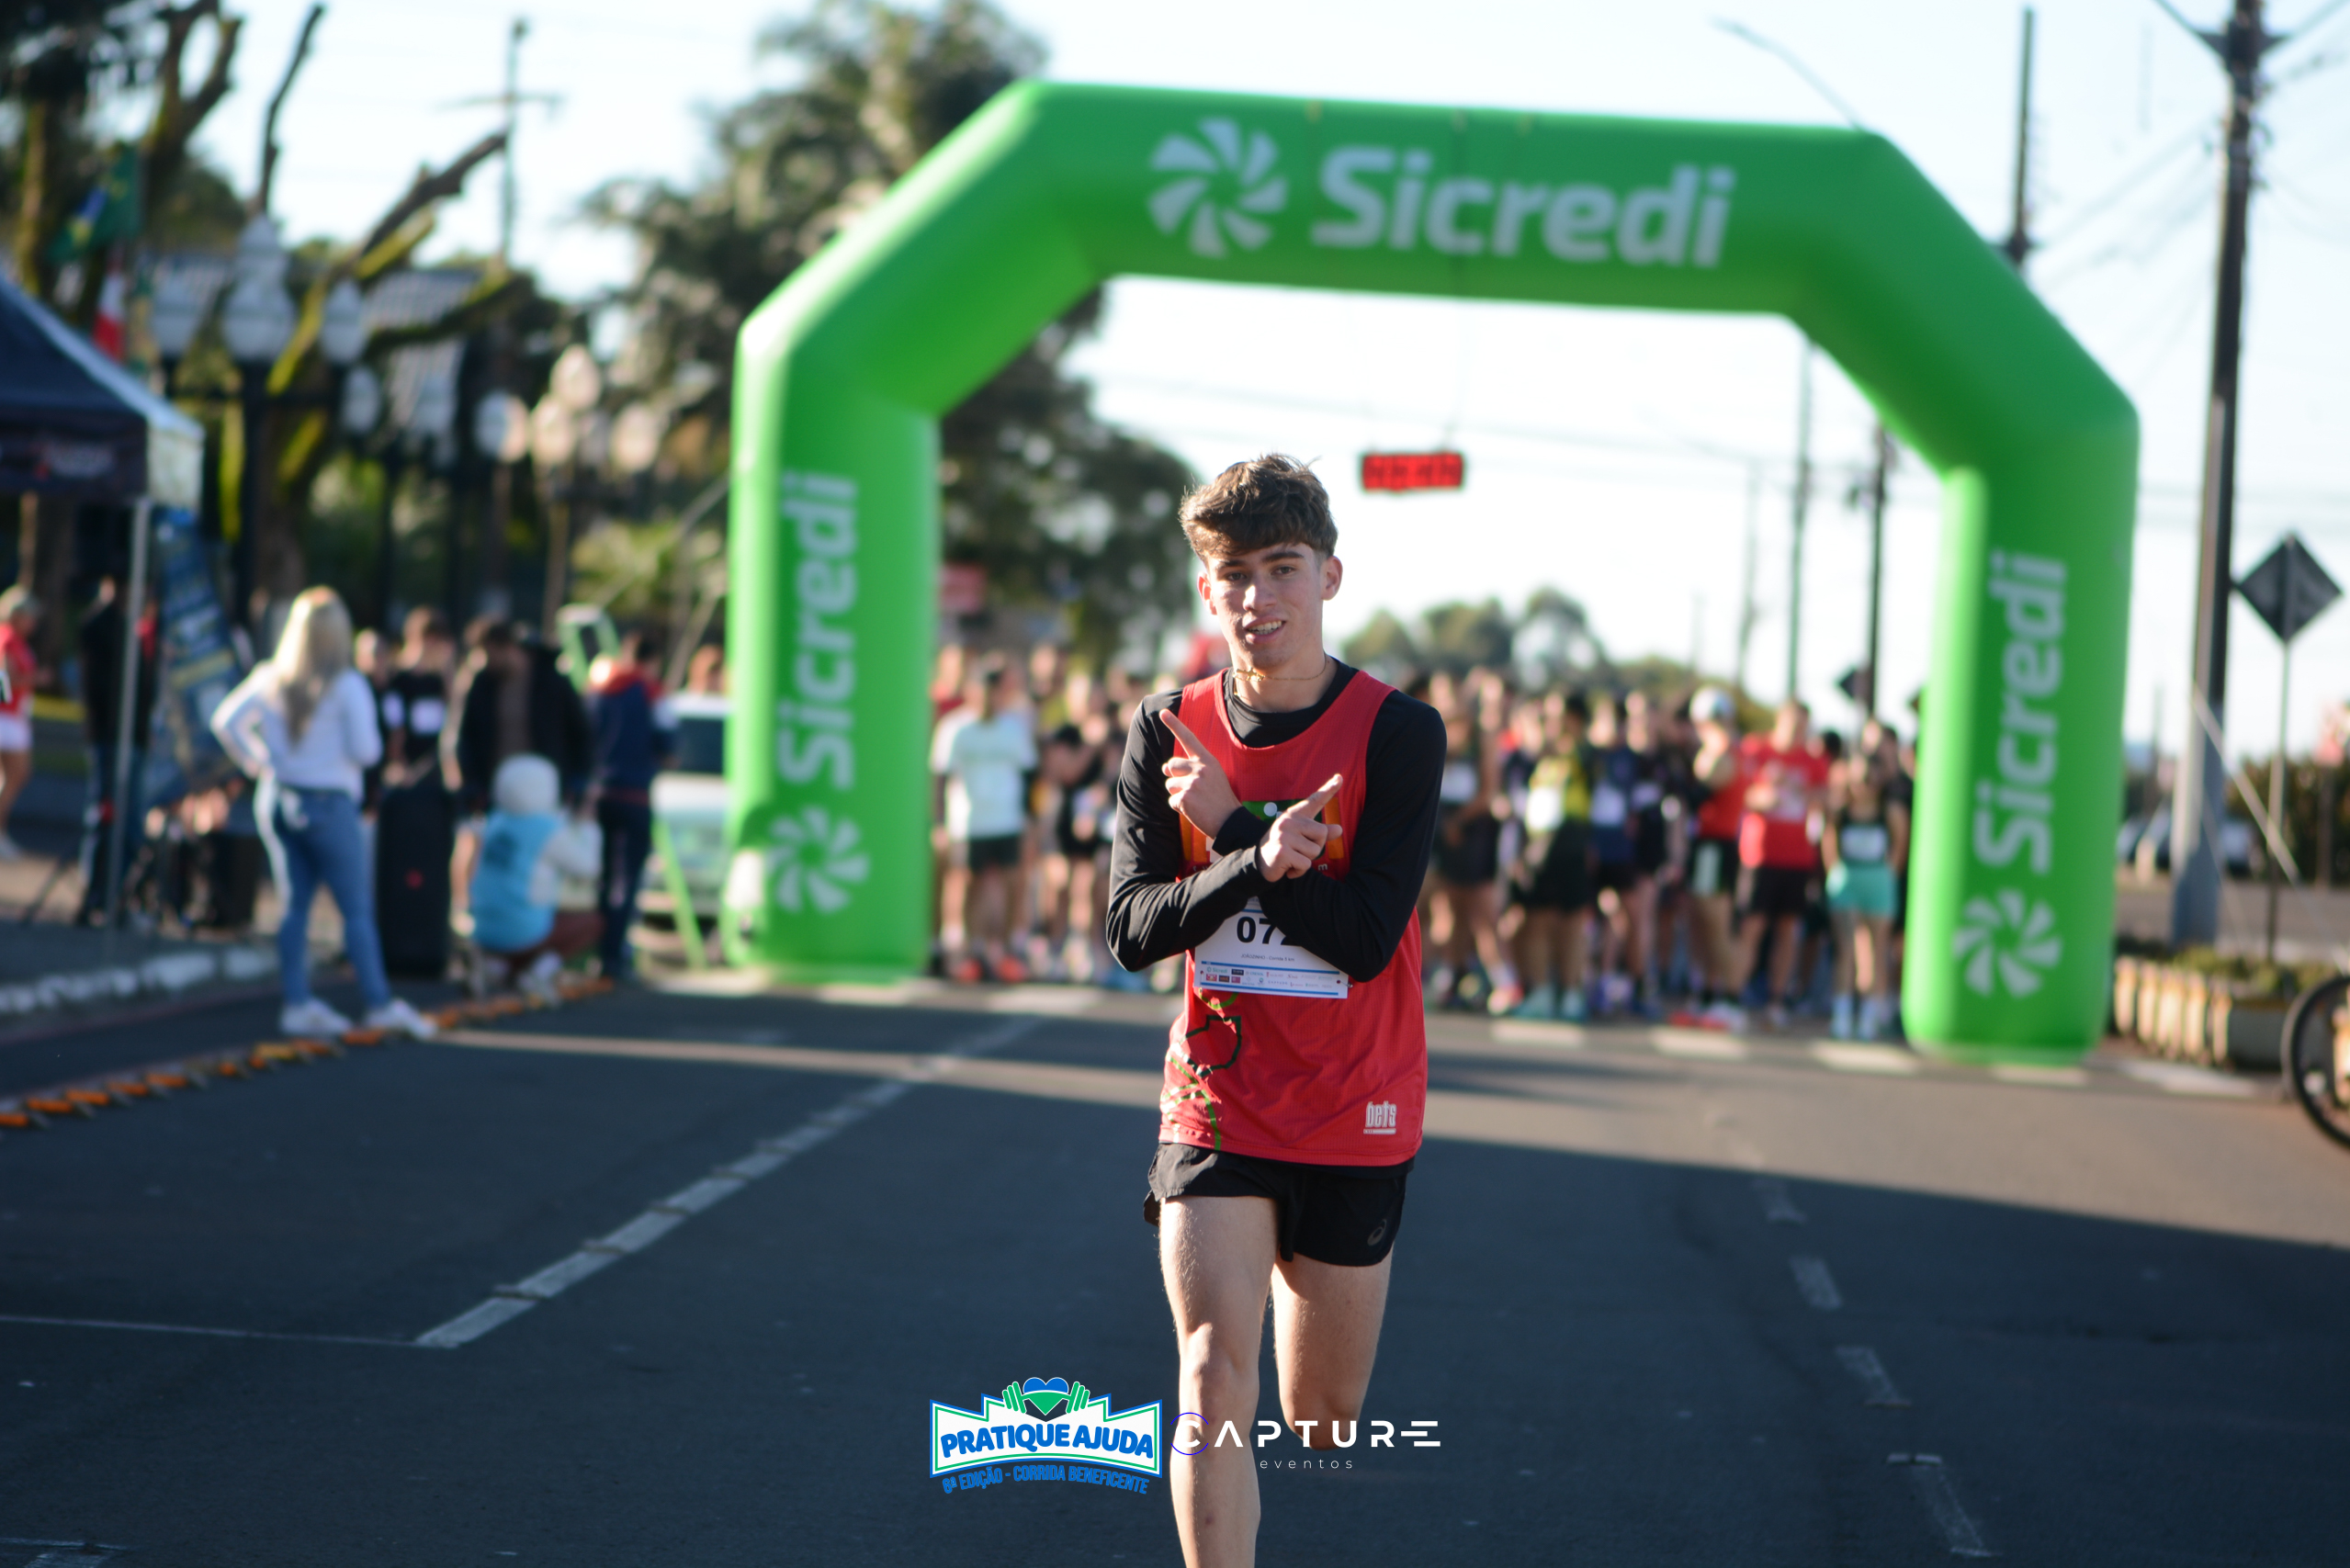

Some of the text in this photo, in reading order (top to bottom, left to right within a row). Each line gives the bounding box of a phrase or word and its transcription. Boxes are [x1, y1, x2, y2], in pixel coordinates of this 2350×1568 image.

[1310, 144, 1736, 268] Sicredi
[778, 470, 858, 790] Sicredi
[1972, 547, 2068, 875] Sicredi
[1365, 1100, 1397, 1128] bets
